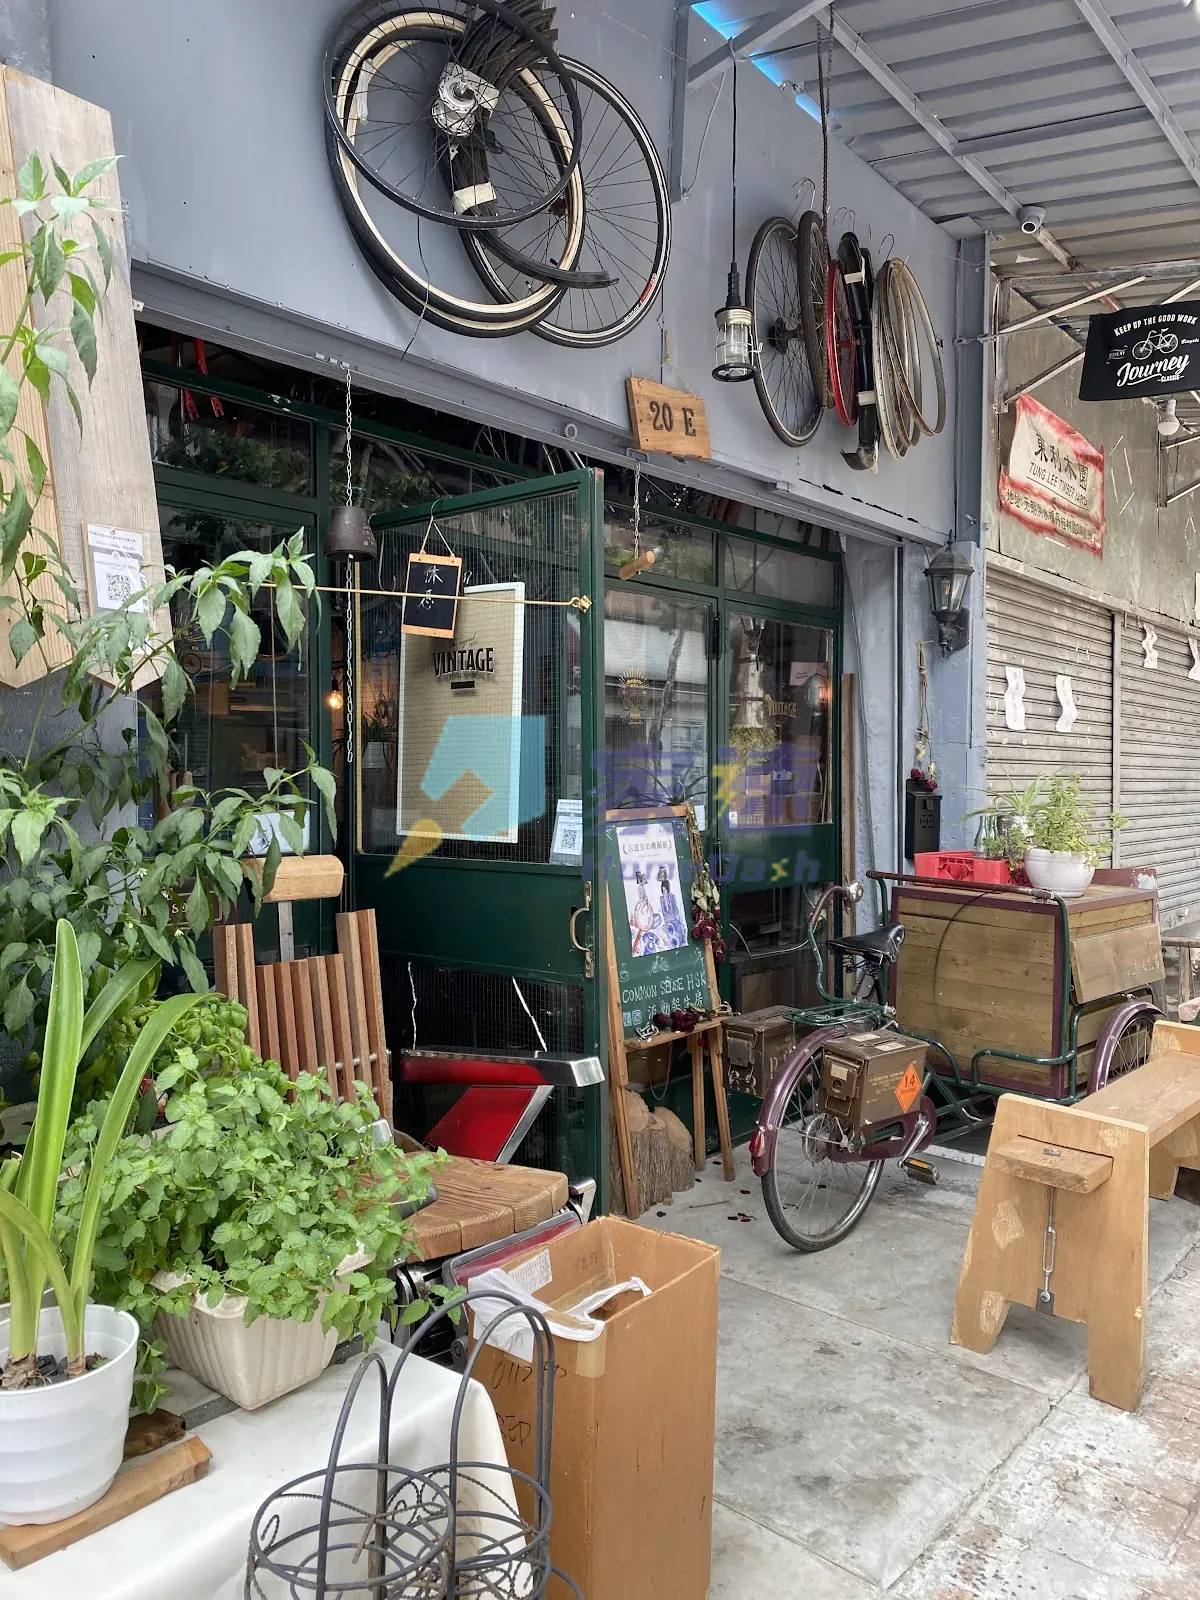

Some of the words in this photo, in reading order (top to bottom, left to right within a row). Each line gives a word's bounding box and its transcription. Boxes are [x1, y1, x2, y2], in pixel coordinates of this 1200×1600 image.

[1113, 323, 1132, 337] KEEP
[1132, 320, 1142, 330] UP
[1143, 316, 1157, 326] THE
[1158, 314, 1176, 323] GOOD
[1177, 314, 1198, 325] WORK
[1116, 354, 1190, 387] Journey
[650, 401, 674, 432] 20
[682, 407, 696, 436] E
[1029, 461, 1046, 480] TUNG
[1046, 471, 1058, 487] LEE
[433, 647, 495, 677] VINTAGE
[622, 984, 657, 1004] COMMON
[686, 971, 707, 991] HSK
